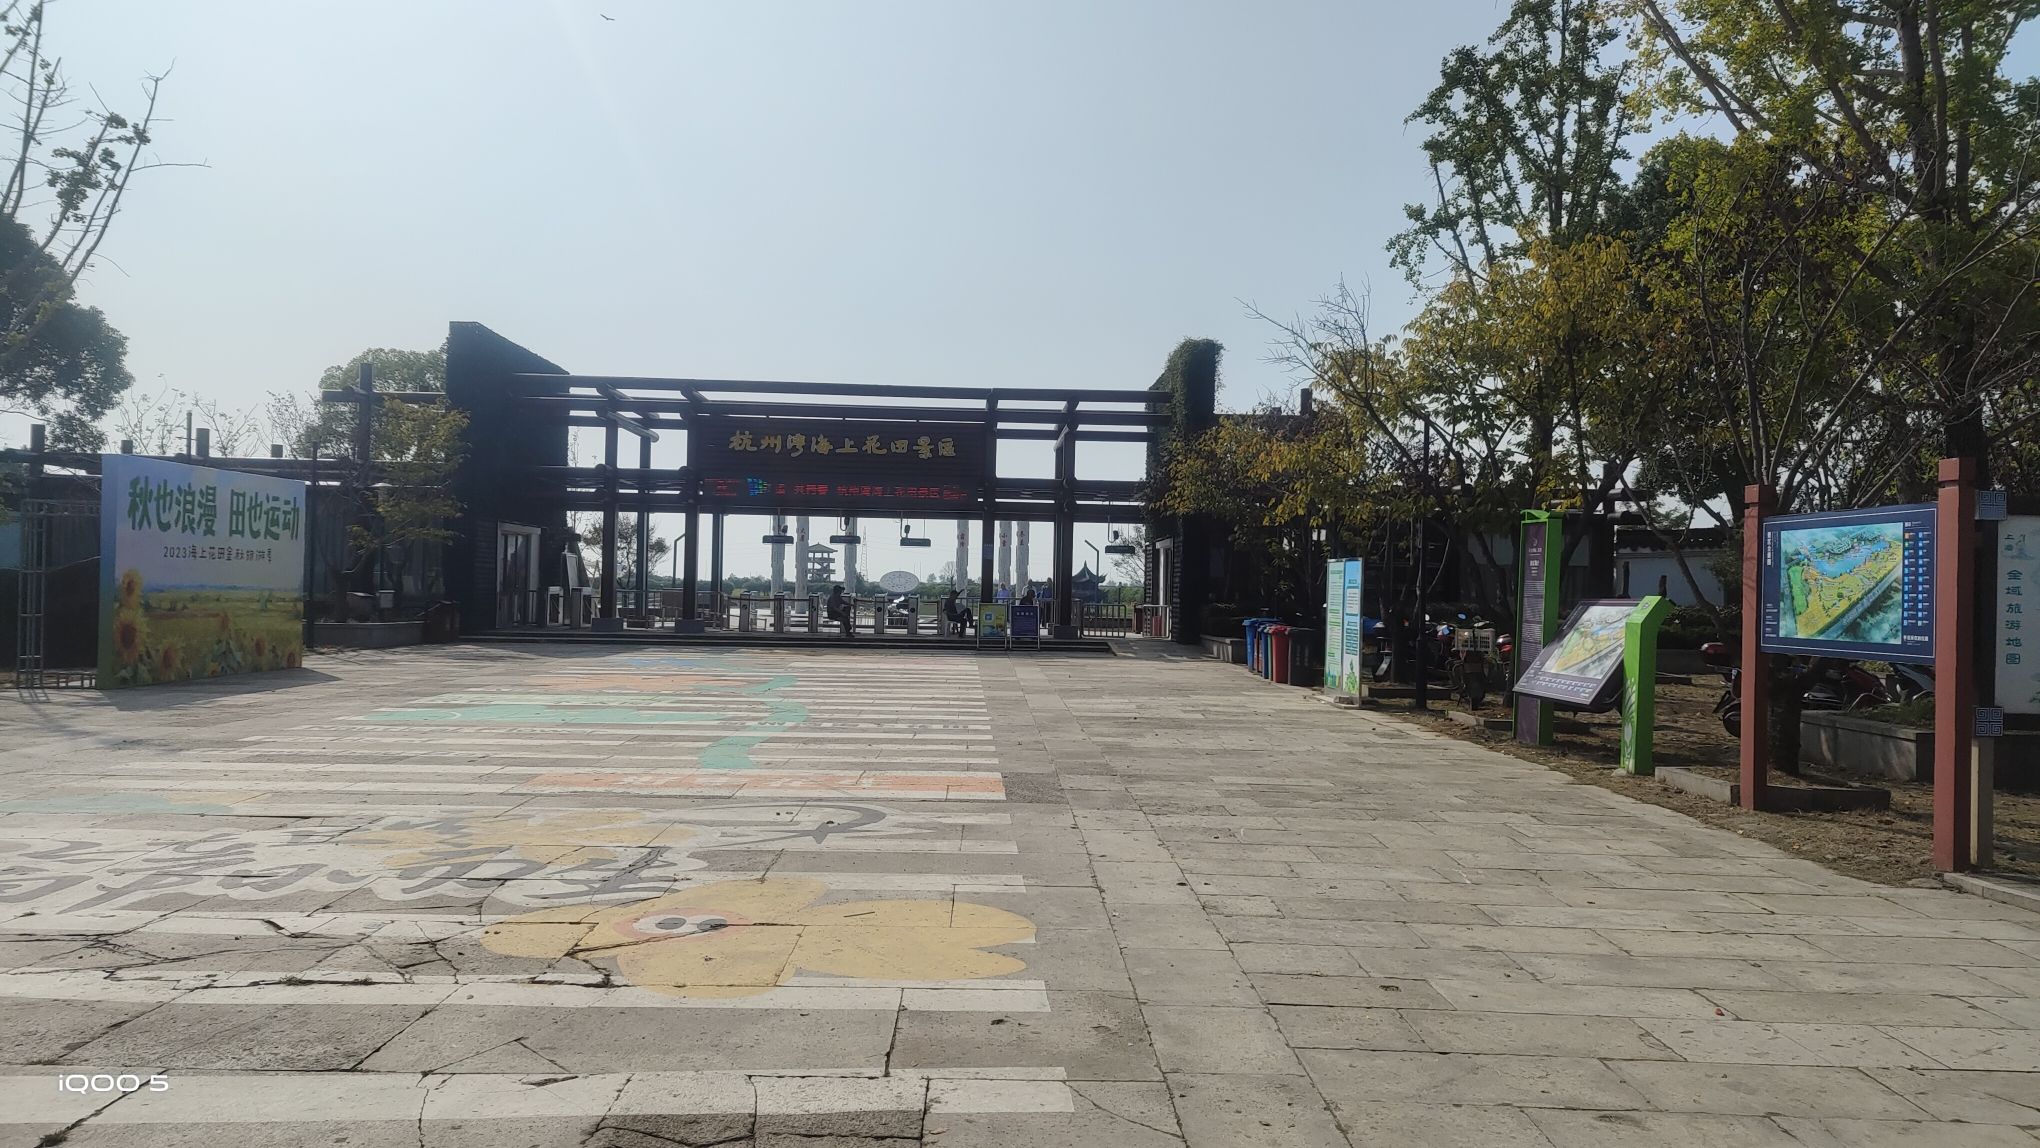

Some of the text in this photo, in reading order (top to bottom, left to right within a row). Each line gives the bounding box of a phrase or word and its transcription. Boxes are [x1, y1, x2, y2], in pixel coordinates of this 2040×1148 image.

[128, 476, 300, 541] 秋也浪漫 田也运动
[2005, 569, 2024, 665] 全域旅游地图
